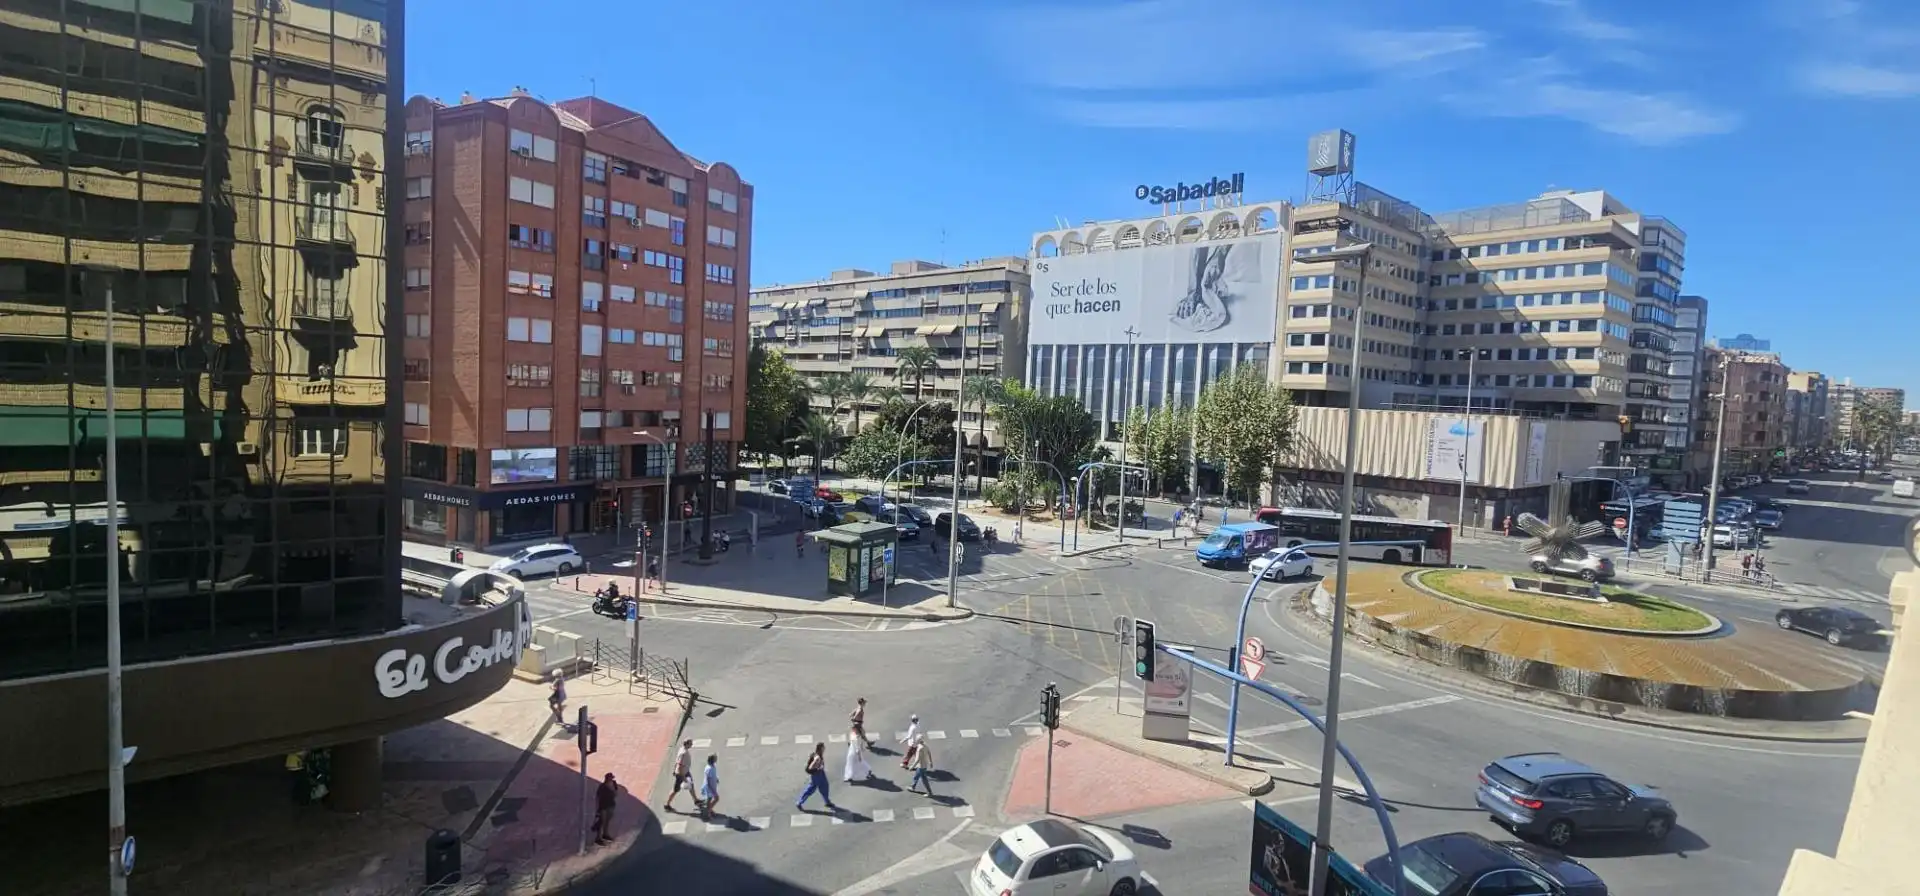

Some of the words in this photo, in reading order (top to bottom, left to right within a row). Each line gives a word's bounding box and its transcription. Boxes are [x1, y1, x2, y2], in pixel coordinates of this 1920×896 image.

[1149, 172, 1244, 205] Sabadell
[1051, 281, 1074, 298] Ser
[1076, 279, 1094, 296] de
[1096, 277, 1117, 295] los
[1046, 302, 1071, 319] que
[1074, 298, 1121, 314] hacen
[424, 492, 445, 502] AEDAS
[446, 496, 470, 506] HOMES
[505, 496, 540, 506] AEDAS
[543, 492, 576, 502] HOMES
[375, 649, 429, 698] El
[433, 628, 513, 684] Corte
